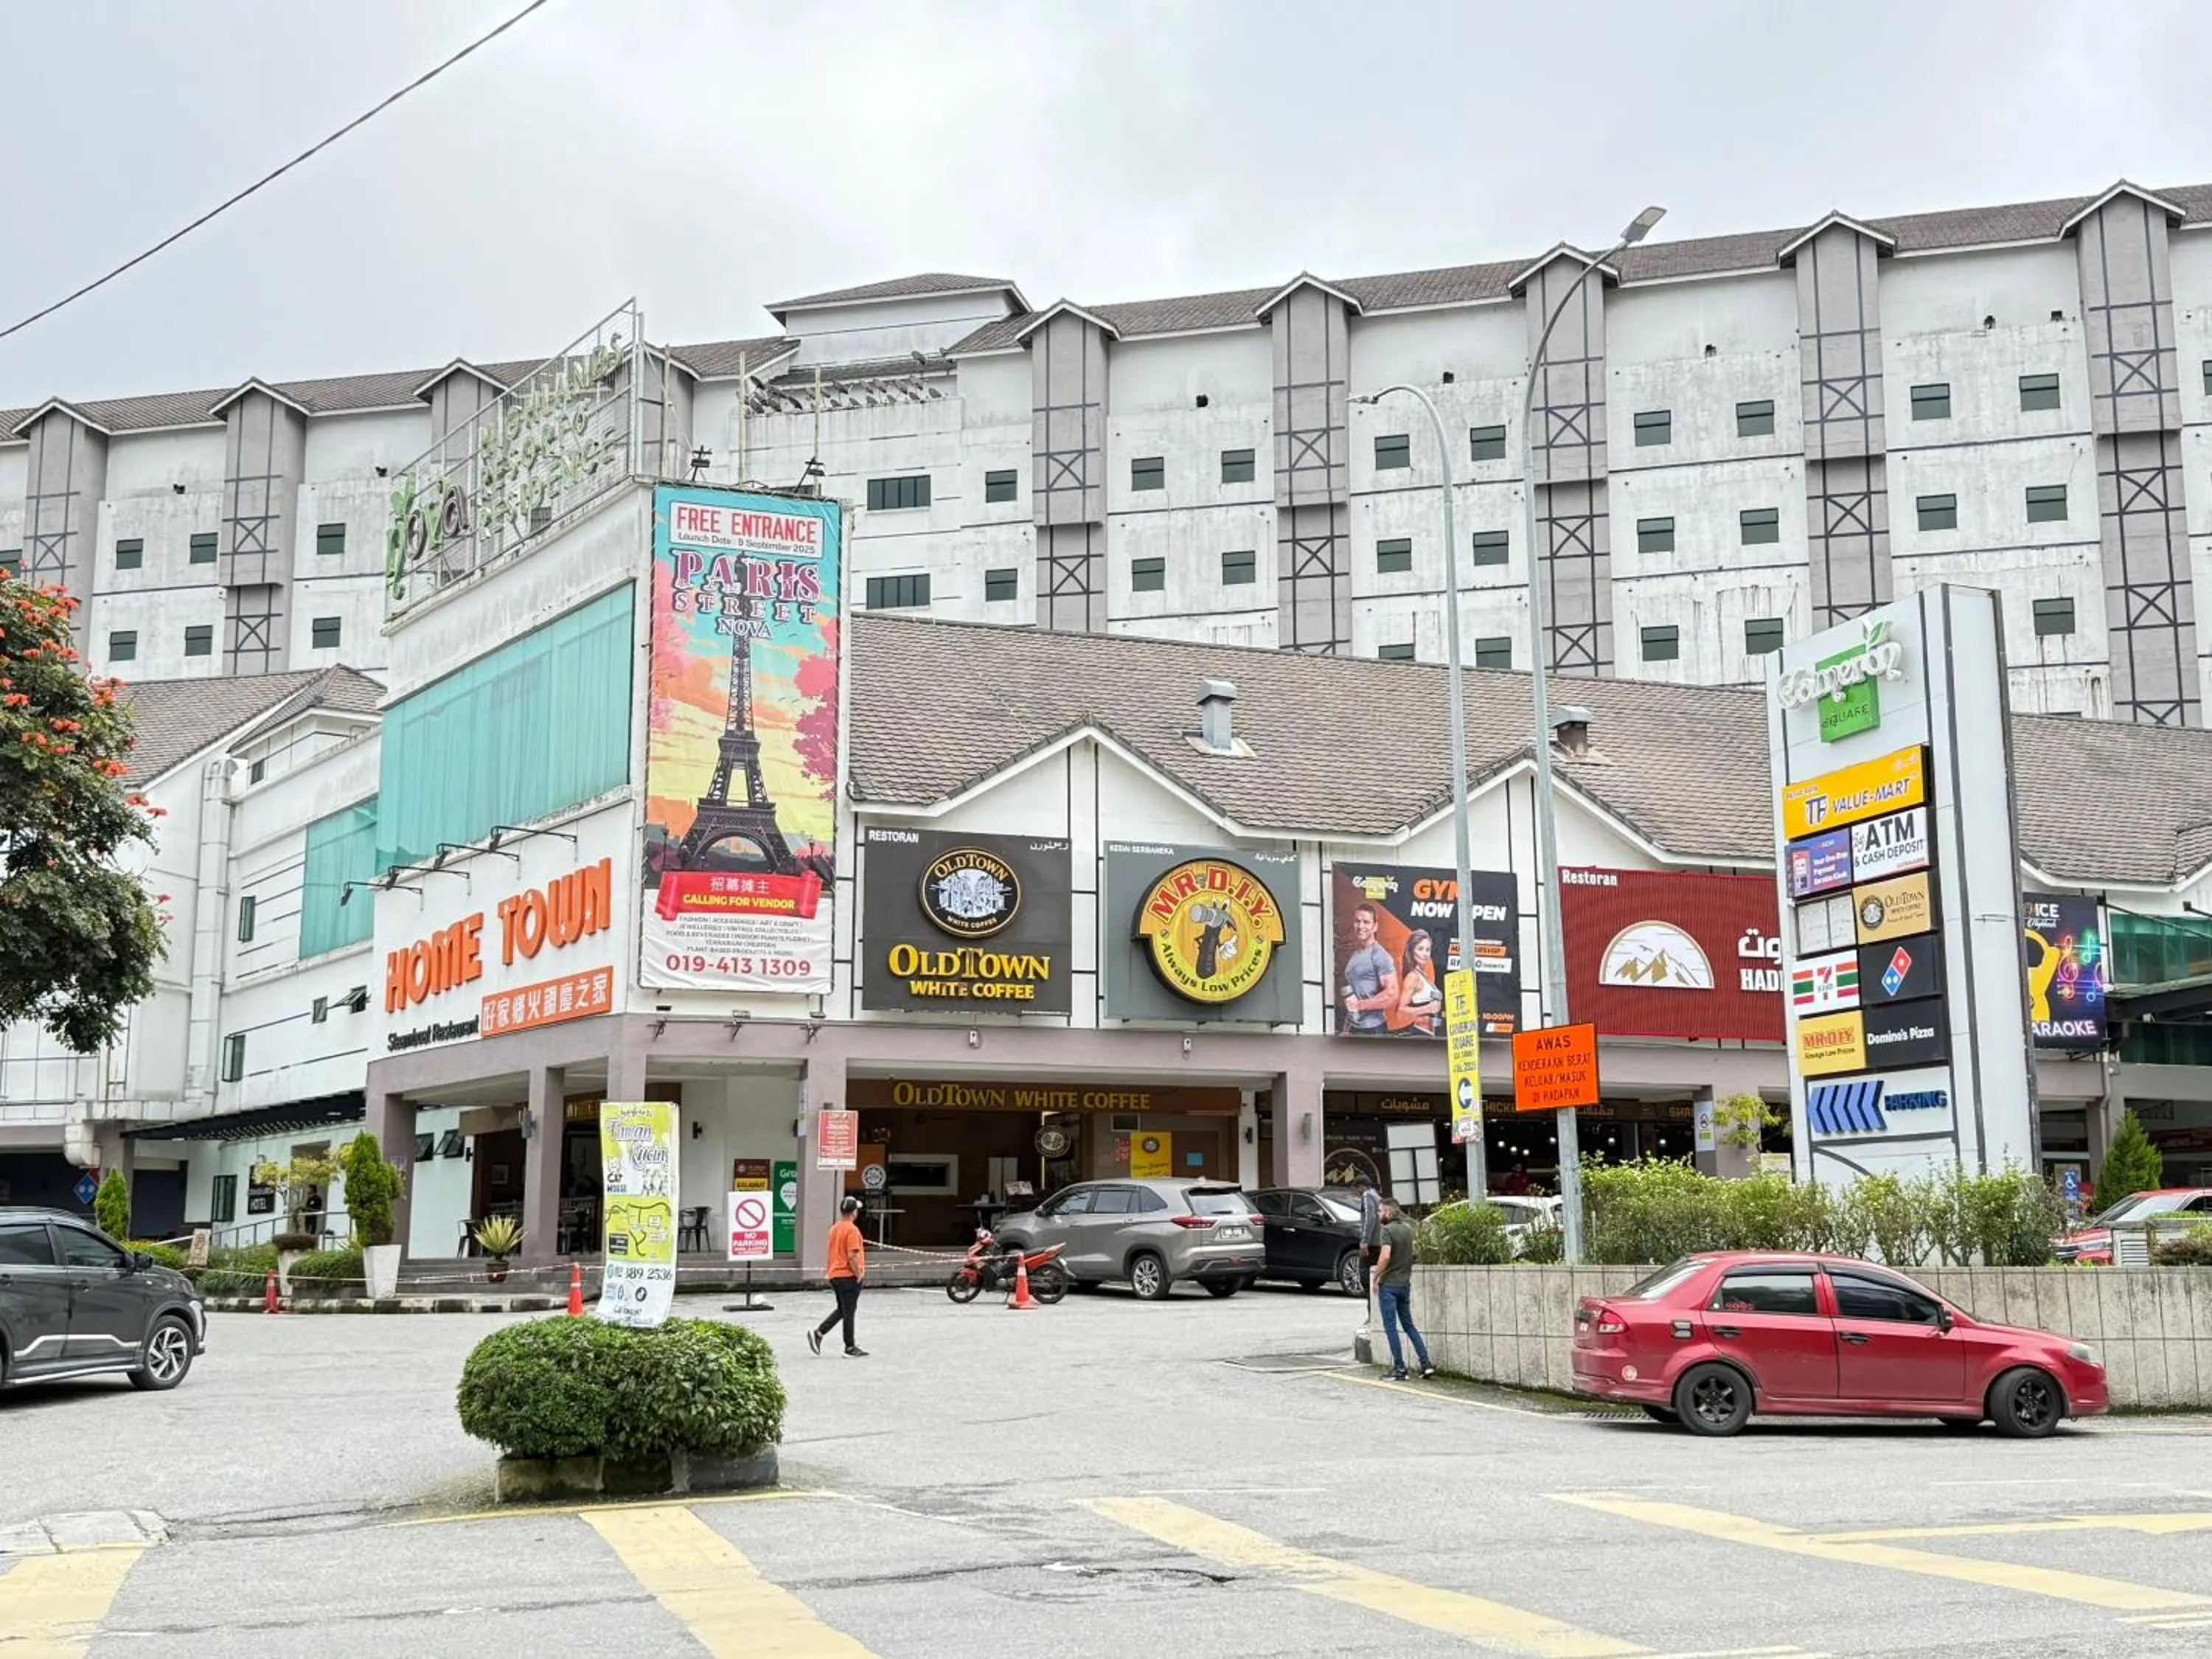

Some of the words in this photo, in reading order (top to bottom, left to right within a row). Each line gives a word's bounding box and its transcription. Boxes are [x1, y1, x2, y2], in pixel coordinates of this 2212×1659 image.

[677, 507, 721, 533] FREE
[731, 512, 817, 543] ENTRANCE
[678, 532, 710, 542] Launch
[712, 536, 731, 545] Date
[745, 539, 792, 552] September
[793, 543, 815, 554] 2025
[672, 550, 820, 602] PARIS
[675, 592, 815, 623] STREET
[717, 617, 772, 639] NOVA
[1821, 704, 1870, 727] SQUARE
[1805, 795, 1827, 824] TF
[1832, 779, 1910, 813] VALUE-MART
[869, 830, 919, 843] RESTORAN
[1865, 813, 1915, 851] ATM
[1862, 849, 1885, 866] CASH
[1887, 839, 1924, 859] DEPOSIT
[1562, 869, 1618, 886] Restoran
[684, 894, 727, 905] CALLING
[729, 897, 750, 907] FOR
[751, 898, 796, 909] VENDOR
[1410, 901, 1455, 918] NOW
[1472, 905, 1506, 921] PEN
[385, 912, 484, 1014] HOME
[498, 858, 611, 965] TOWN
[666, 954, 752, 974] 019-413
[759, 958, 811, 976] 1309
[888, 944, 1050, 980] OLDTOWN
[1162, 942, 1197, 987] Always
[1201, 981, 1229, 992] Low
[1232, 947, 1263, 987] Prices
[910, 980, 968, 996] WHITE
[973, 982, 1034, 1000] COFFEE
[1867, 1029, 1908, 1045] Domino's
[1910, 1026, 1935, 1040] Pizza
[2031, 1020, 2098, 1037] ARAOKE
[1536, 1034, 1571, 1051] AWAS
[1518, 1056, 1564, 1071] KENDERAAN
[1567, 1052, 1591, 1066] BERAT
[1524, 1071, 1586, 1088] KELUAR/MASUK
[894, 1082, 1005, 1107] OLDTOWN
[1015, 1091, 1077, 1108] WHITE
[1083, 1092, 1150, 1110] COFFEE
[1533, 1092, 1540, 1103] DI
[1544, 1088, 1579, 1102] HADAPAN
[1885, 1090, 1947, 1111] PARKING
[607, 1173, 623, 1183] CAT
[744, 1231, 757, 1240] NO
